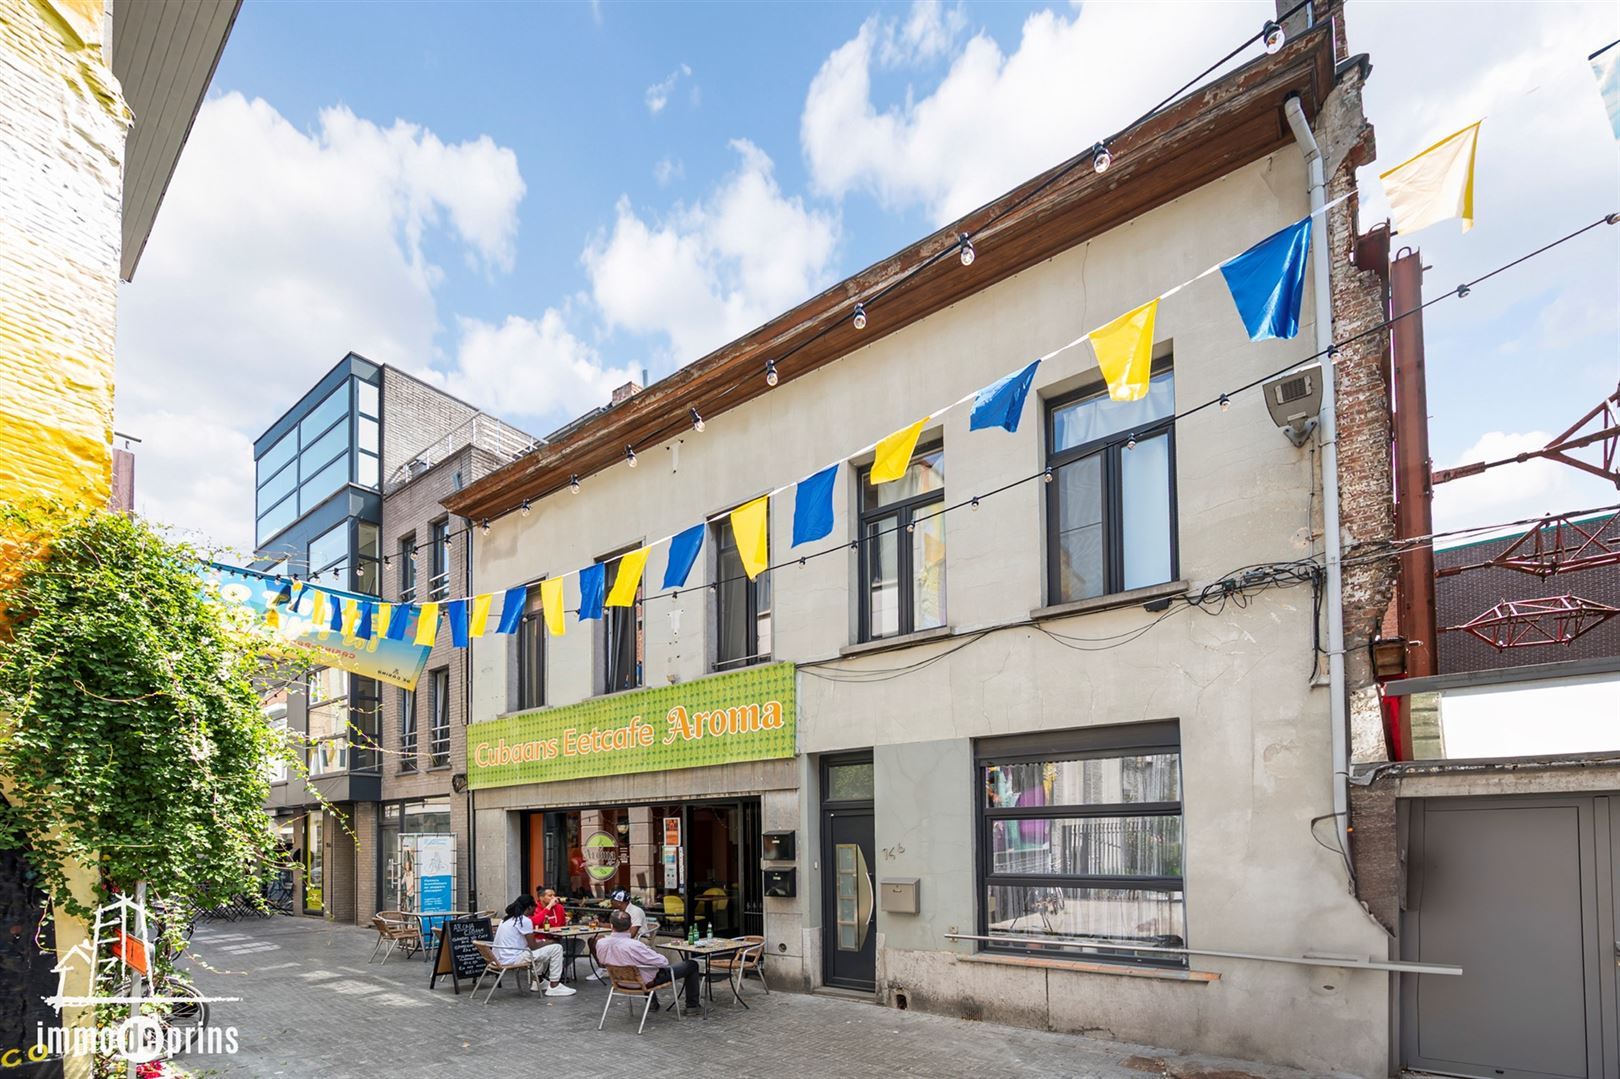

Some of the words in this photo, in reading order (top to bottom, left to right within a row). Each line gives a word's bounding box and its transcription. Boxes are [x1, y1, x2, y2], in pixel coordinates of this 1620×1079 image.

[474, 738, 559, 768] Cubaans
[562, 716, 655, 757] Eetcafe
[662, 699, 786, 745] Aroma
